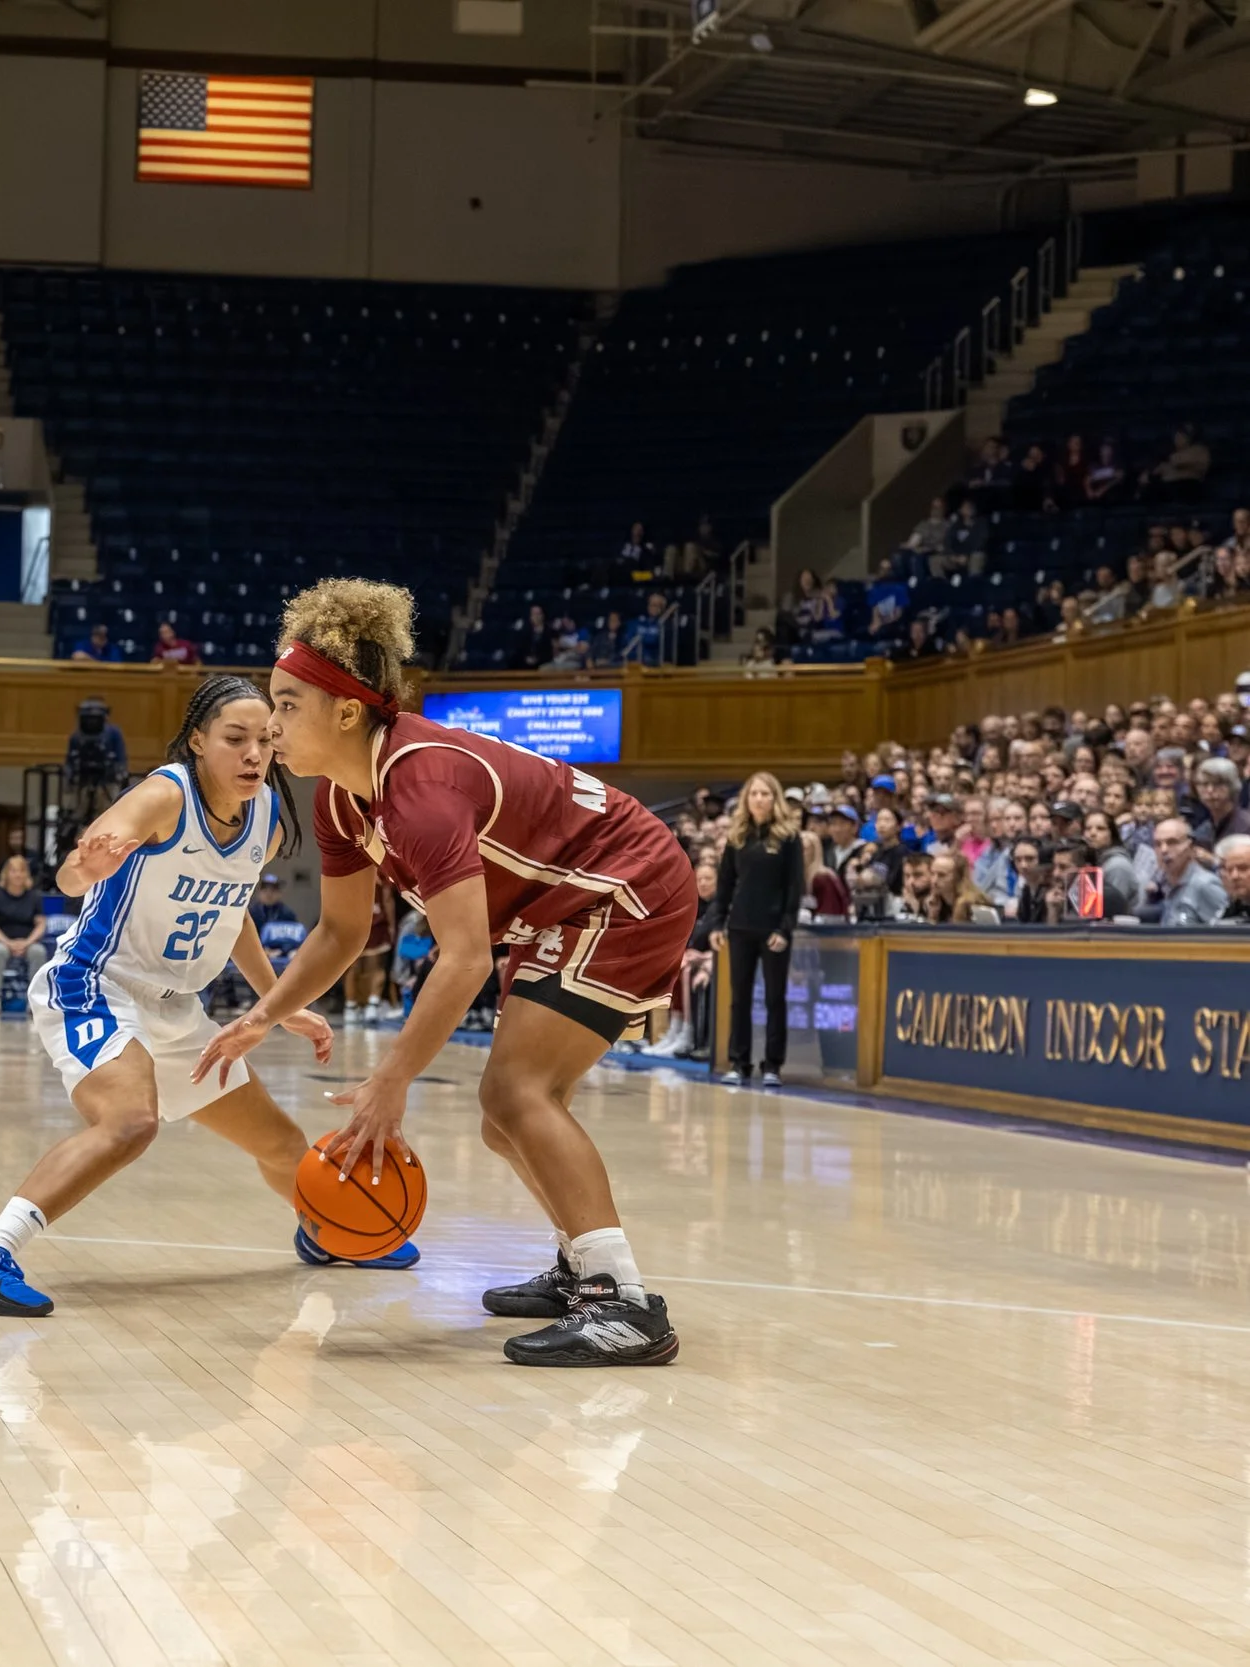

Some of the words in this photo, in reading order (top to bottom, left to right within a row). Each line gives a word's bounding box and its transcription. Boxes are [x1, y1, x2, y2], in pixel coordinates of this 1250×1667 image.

[168, 874, 254, 907] DUKE
[162, 910, 221, 961] 22
[75, 1018, 104, 1050] D
[896, 989, 1028, 1057] CAMERON
[1045, 1000, 1166, 1072] INDOOR
